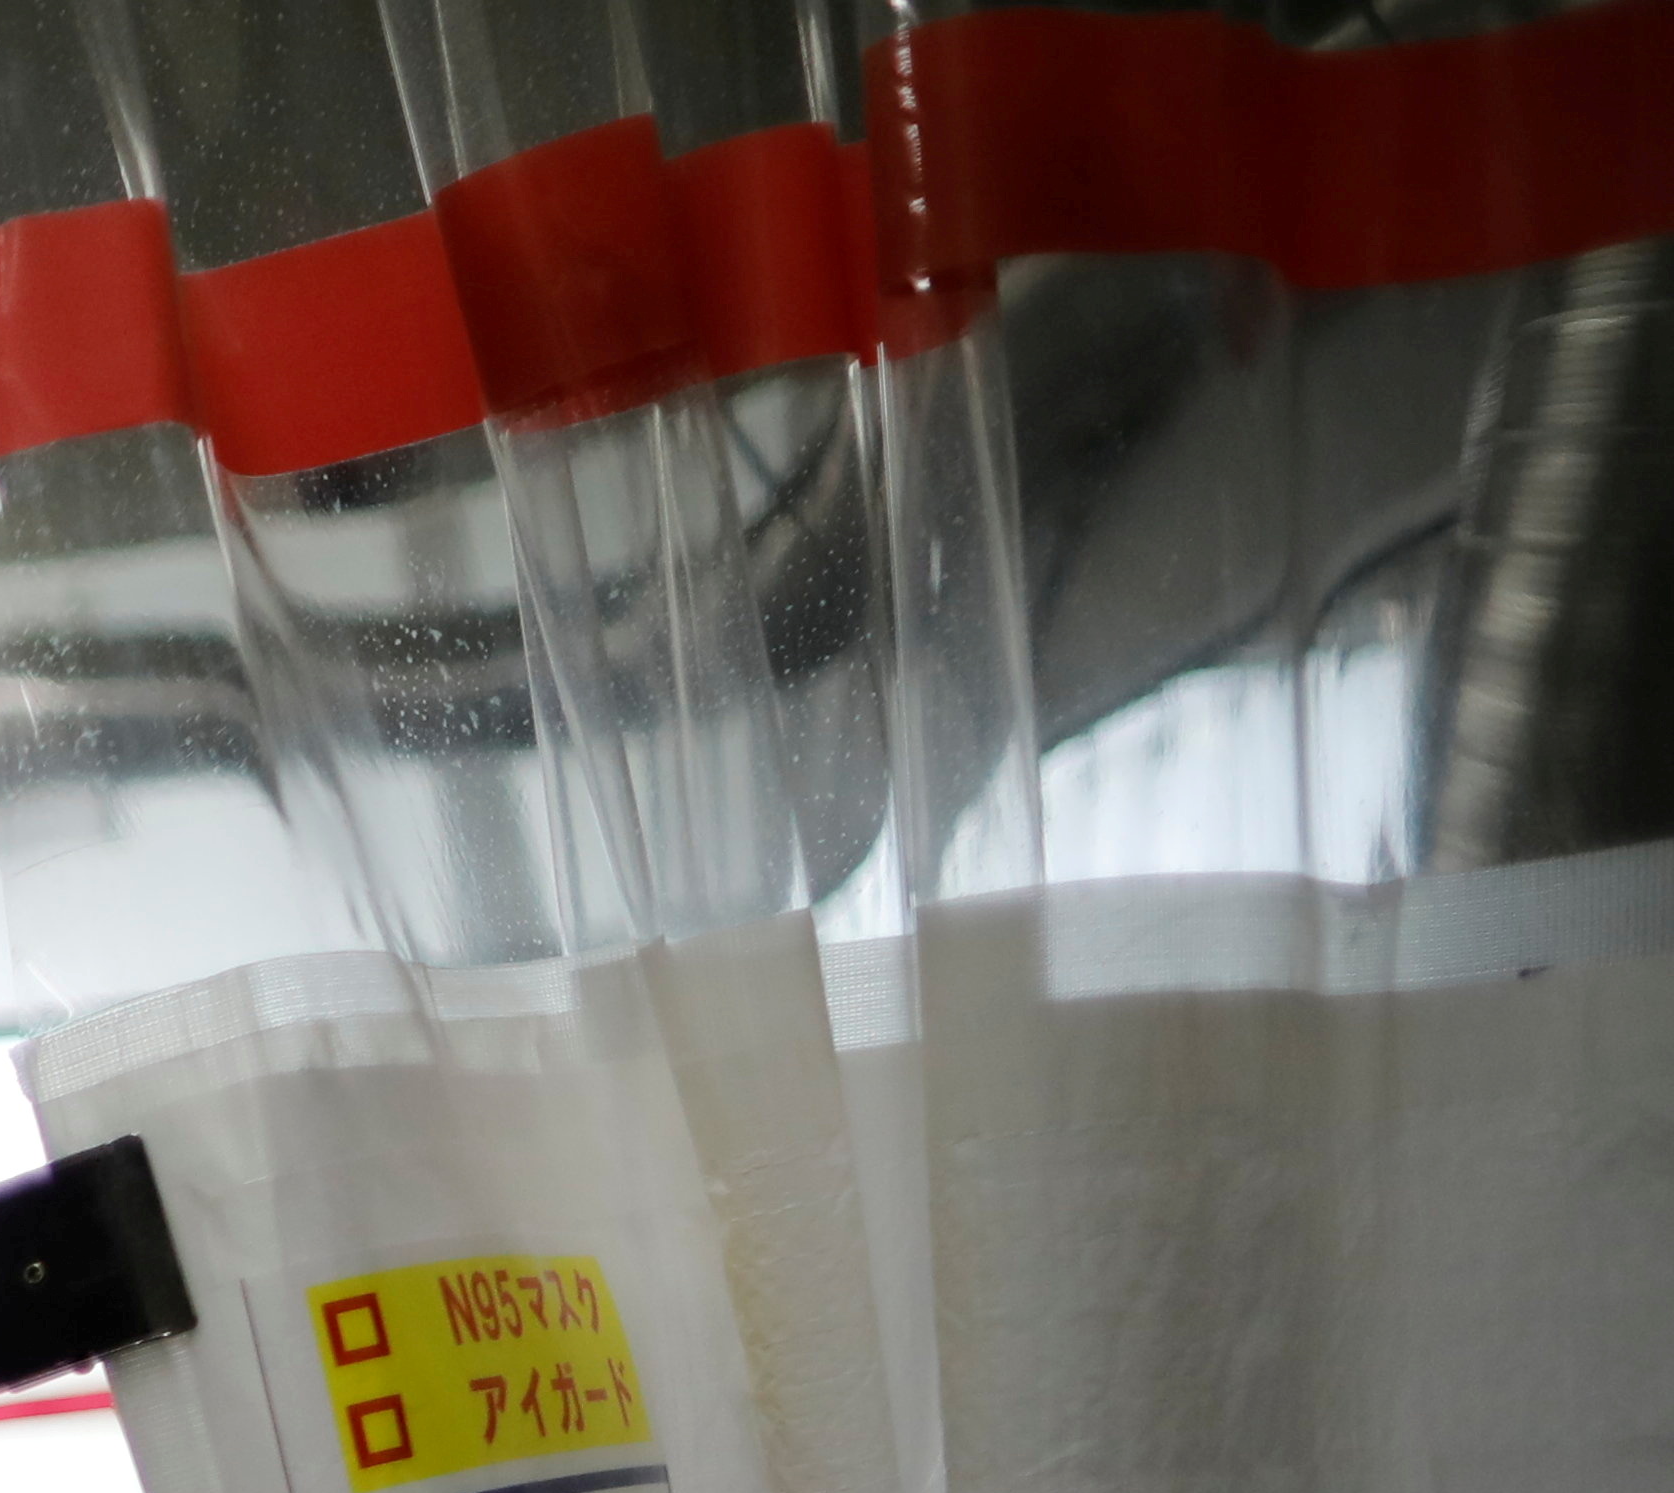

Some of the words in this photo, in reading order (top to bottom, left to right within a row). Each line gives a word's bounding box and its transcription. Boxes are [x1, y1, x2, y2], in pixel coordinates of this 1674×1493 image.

[438, 1268, 601, 1346] N95マスク
[468, 1357, 633, 1446] アイガード
